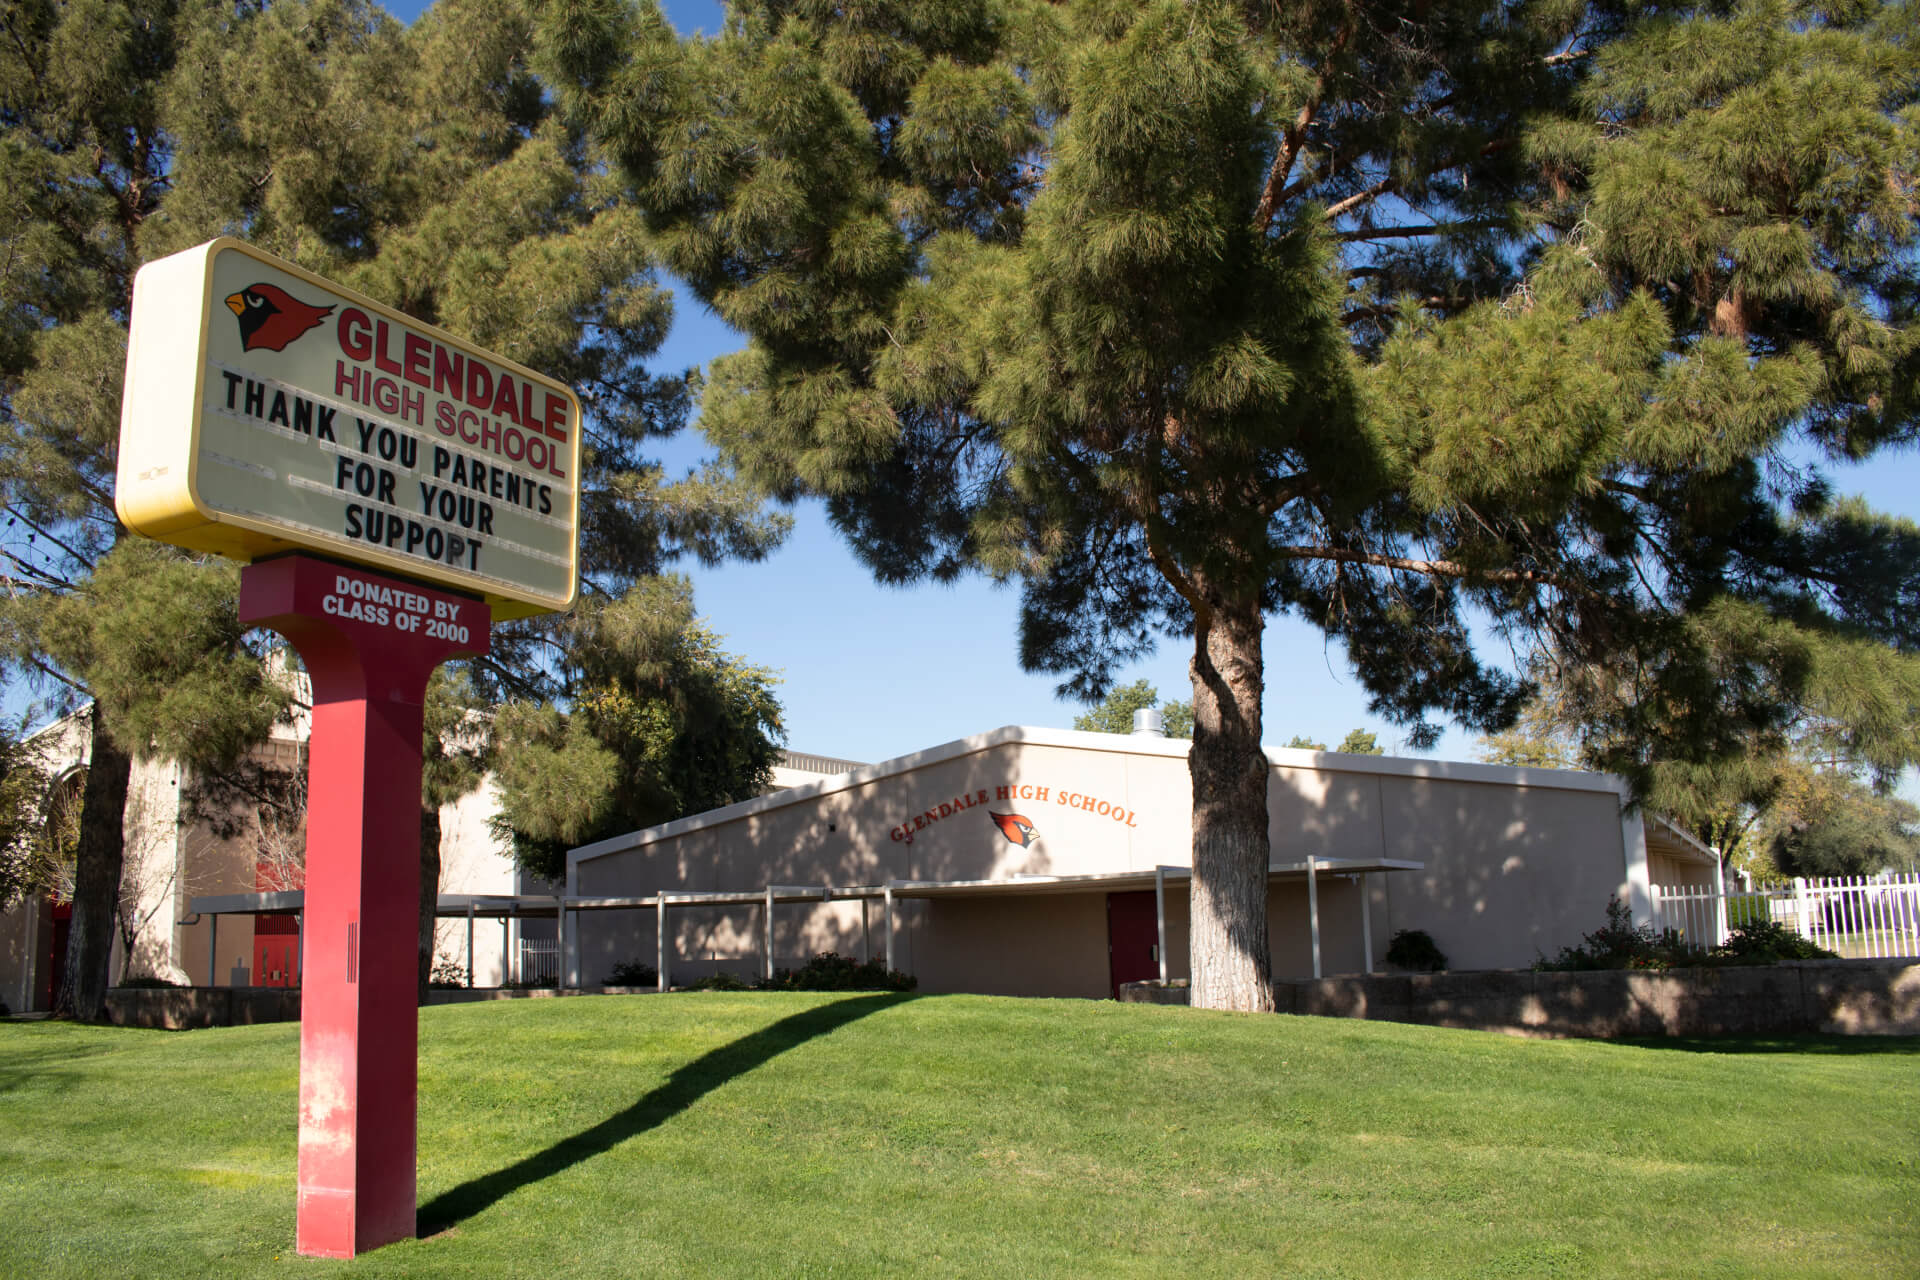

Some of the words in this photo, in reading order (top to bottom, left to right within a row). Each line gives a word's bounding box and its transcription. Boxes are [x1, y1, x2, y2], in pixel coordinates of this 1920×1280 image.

[337, 307, 568, 441] GLENDALE
[223, 371, 337, 443] THANK
[357, 418, 418, 469] YOU
[434, 445, 553, 515] PARENTS
[335, 361, 425, 426] HIGH
[435, 401, 566, 479] SCHOOL
[336, 456, 396, 504] FOR
[420, 482, 494, 536] YOUR
[322, 594, 389, 626] CLASS
[395, 611, 421, 634] OF
[425, 619, 470, 645] 2000
[335, 575, 429, 615] DONATED
[435, 599, 461, 622] BY
[890, 789, 990, 843] GLENDALE
[996, 784, 1050, 802] HIGH
[1057, 790, 1138, 828] SCHOOL
